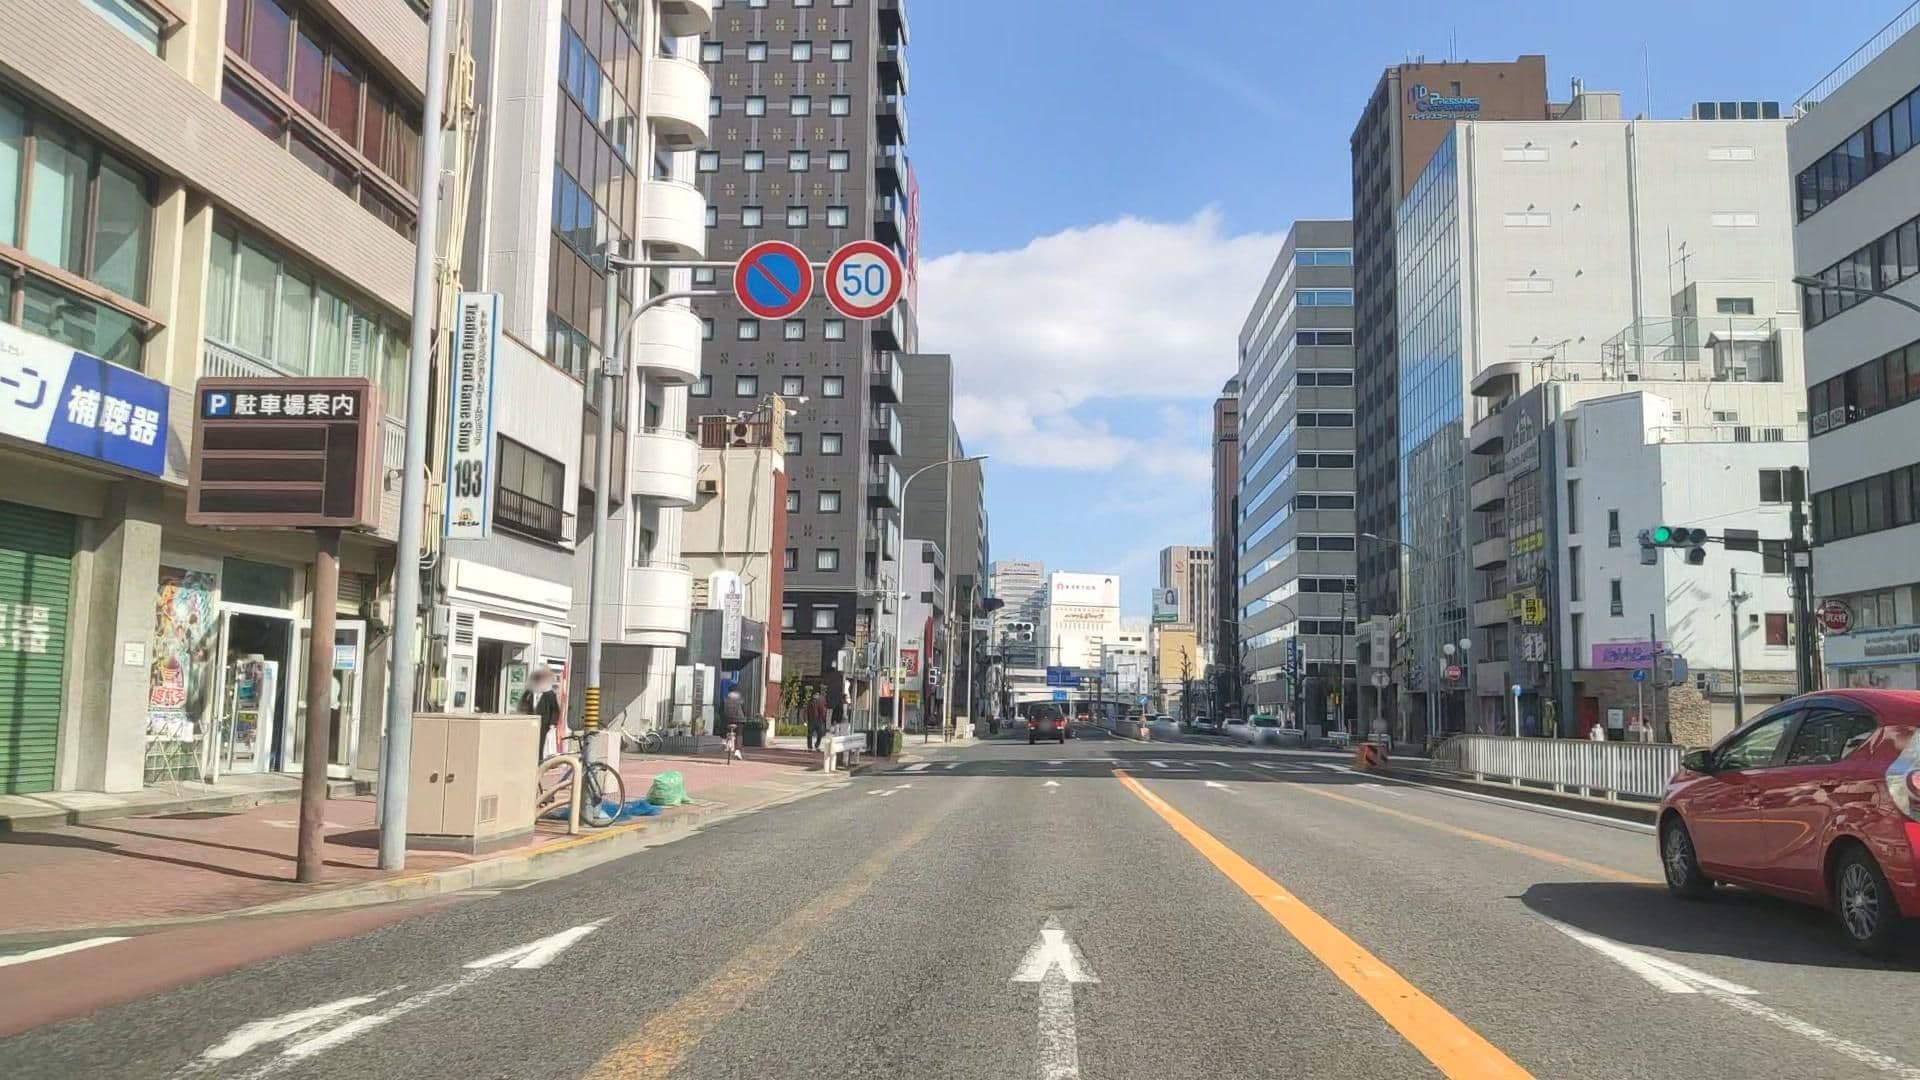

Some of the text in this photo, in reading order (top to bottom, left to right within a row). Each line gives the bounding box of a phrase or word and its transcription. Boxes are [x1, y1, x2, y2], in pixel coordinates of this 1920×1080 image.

[844, 264, 884, 296] 50
[458, 304, 478, 452] Trading Card Game Shop
[67, 384, 160, 446] 補聴器
[210, 393, 355, 416] P 駐車場案内
[455, 460, 483, 498] 193
